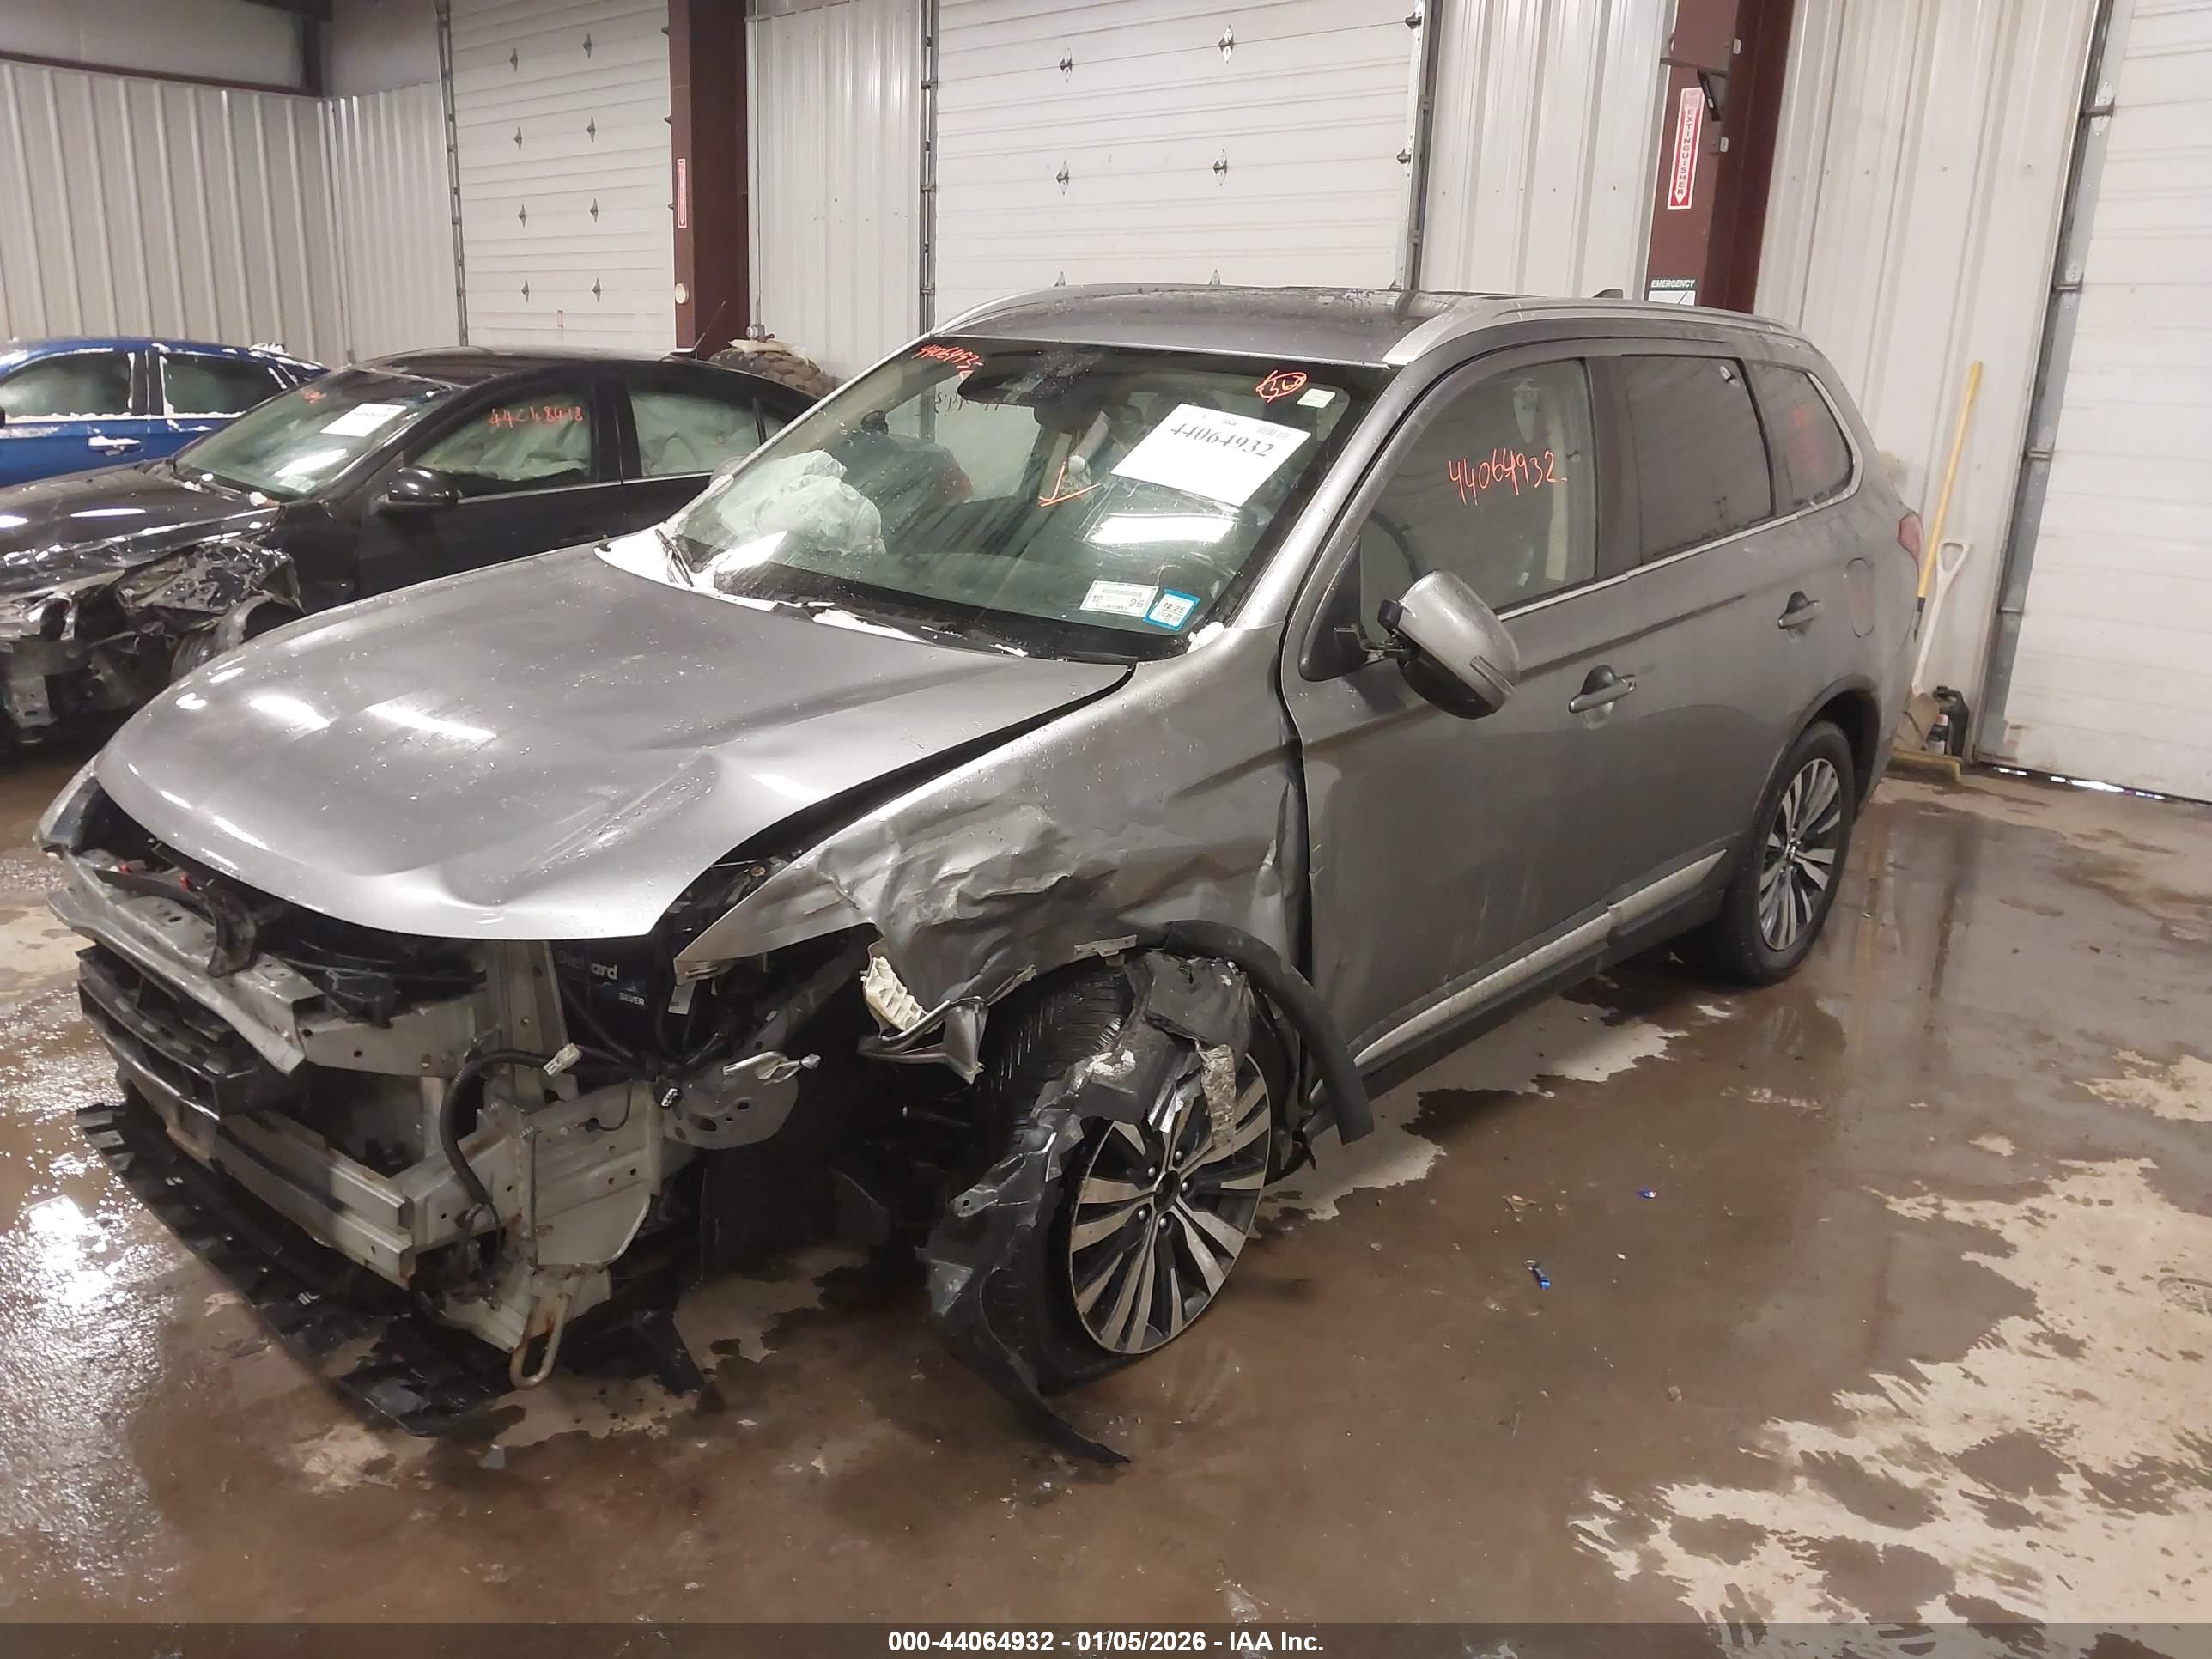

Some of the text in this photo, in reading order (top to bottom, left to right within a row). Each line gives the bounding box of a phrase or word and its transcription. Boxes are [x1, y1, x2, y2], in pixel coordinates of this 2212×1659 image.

[1677, 109, 1694, 196] EXTINGUISHER
[1650, 279, 1696, 288] EMERGENCY
[1170, 422, 1274, 457] 44064932
[1449, 447, 1557, 506] 44064932
[618, 992, 645, 1006] SILVER
